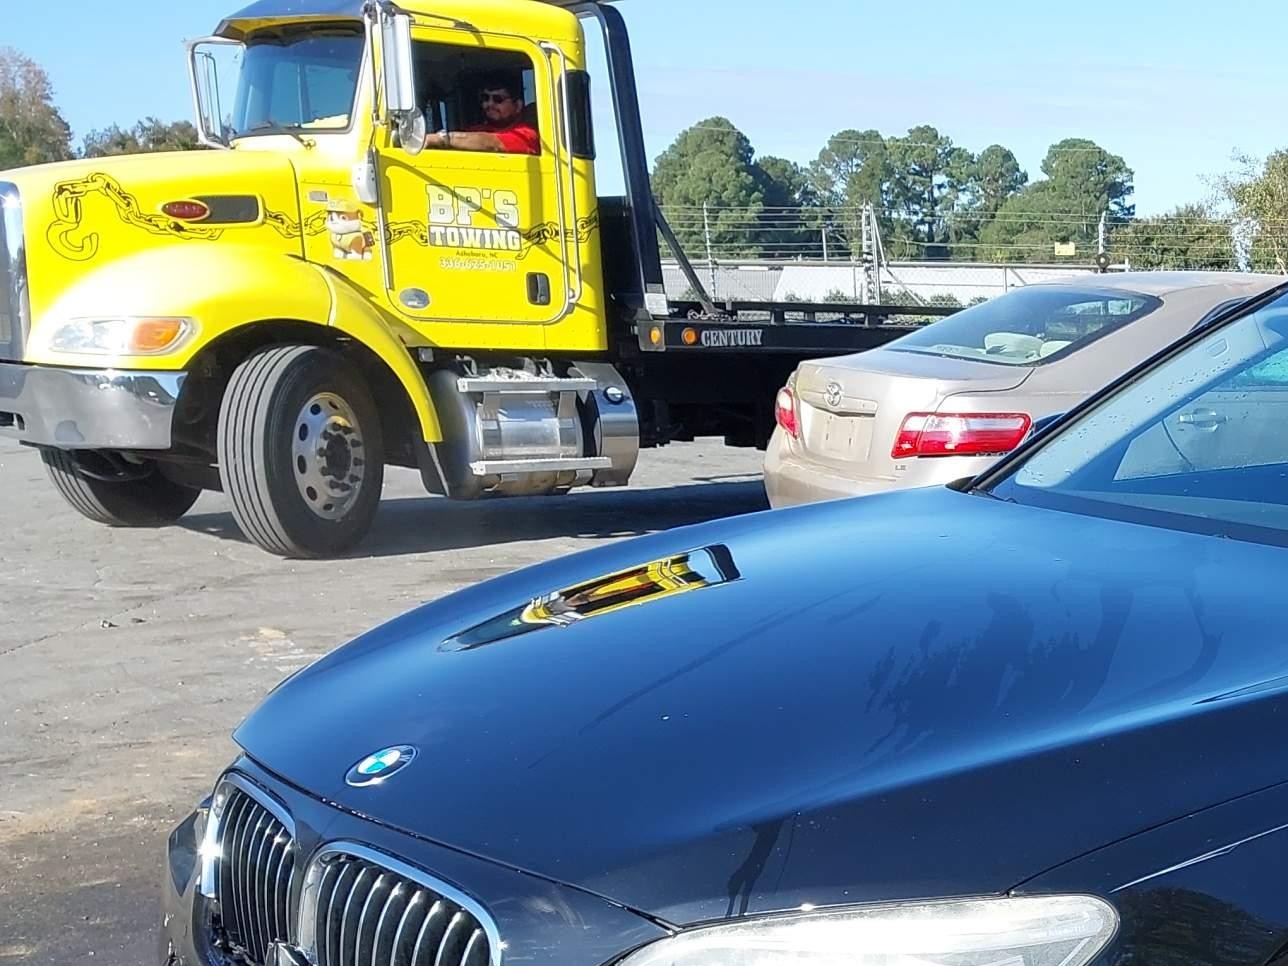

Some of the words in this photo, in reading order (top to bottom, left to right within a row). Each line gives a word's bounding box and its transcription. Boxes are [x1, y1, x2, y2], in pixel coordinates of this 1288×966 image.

[425, 184, 519, 229] BP'S
[429, 226, 521, 251] TOWING
[701, 329, 763, 347] CENTURY
